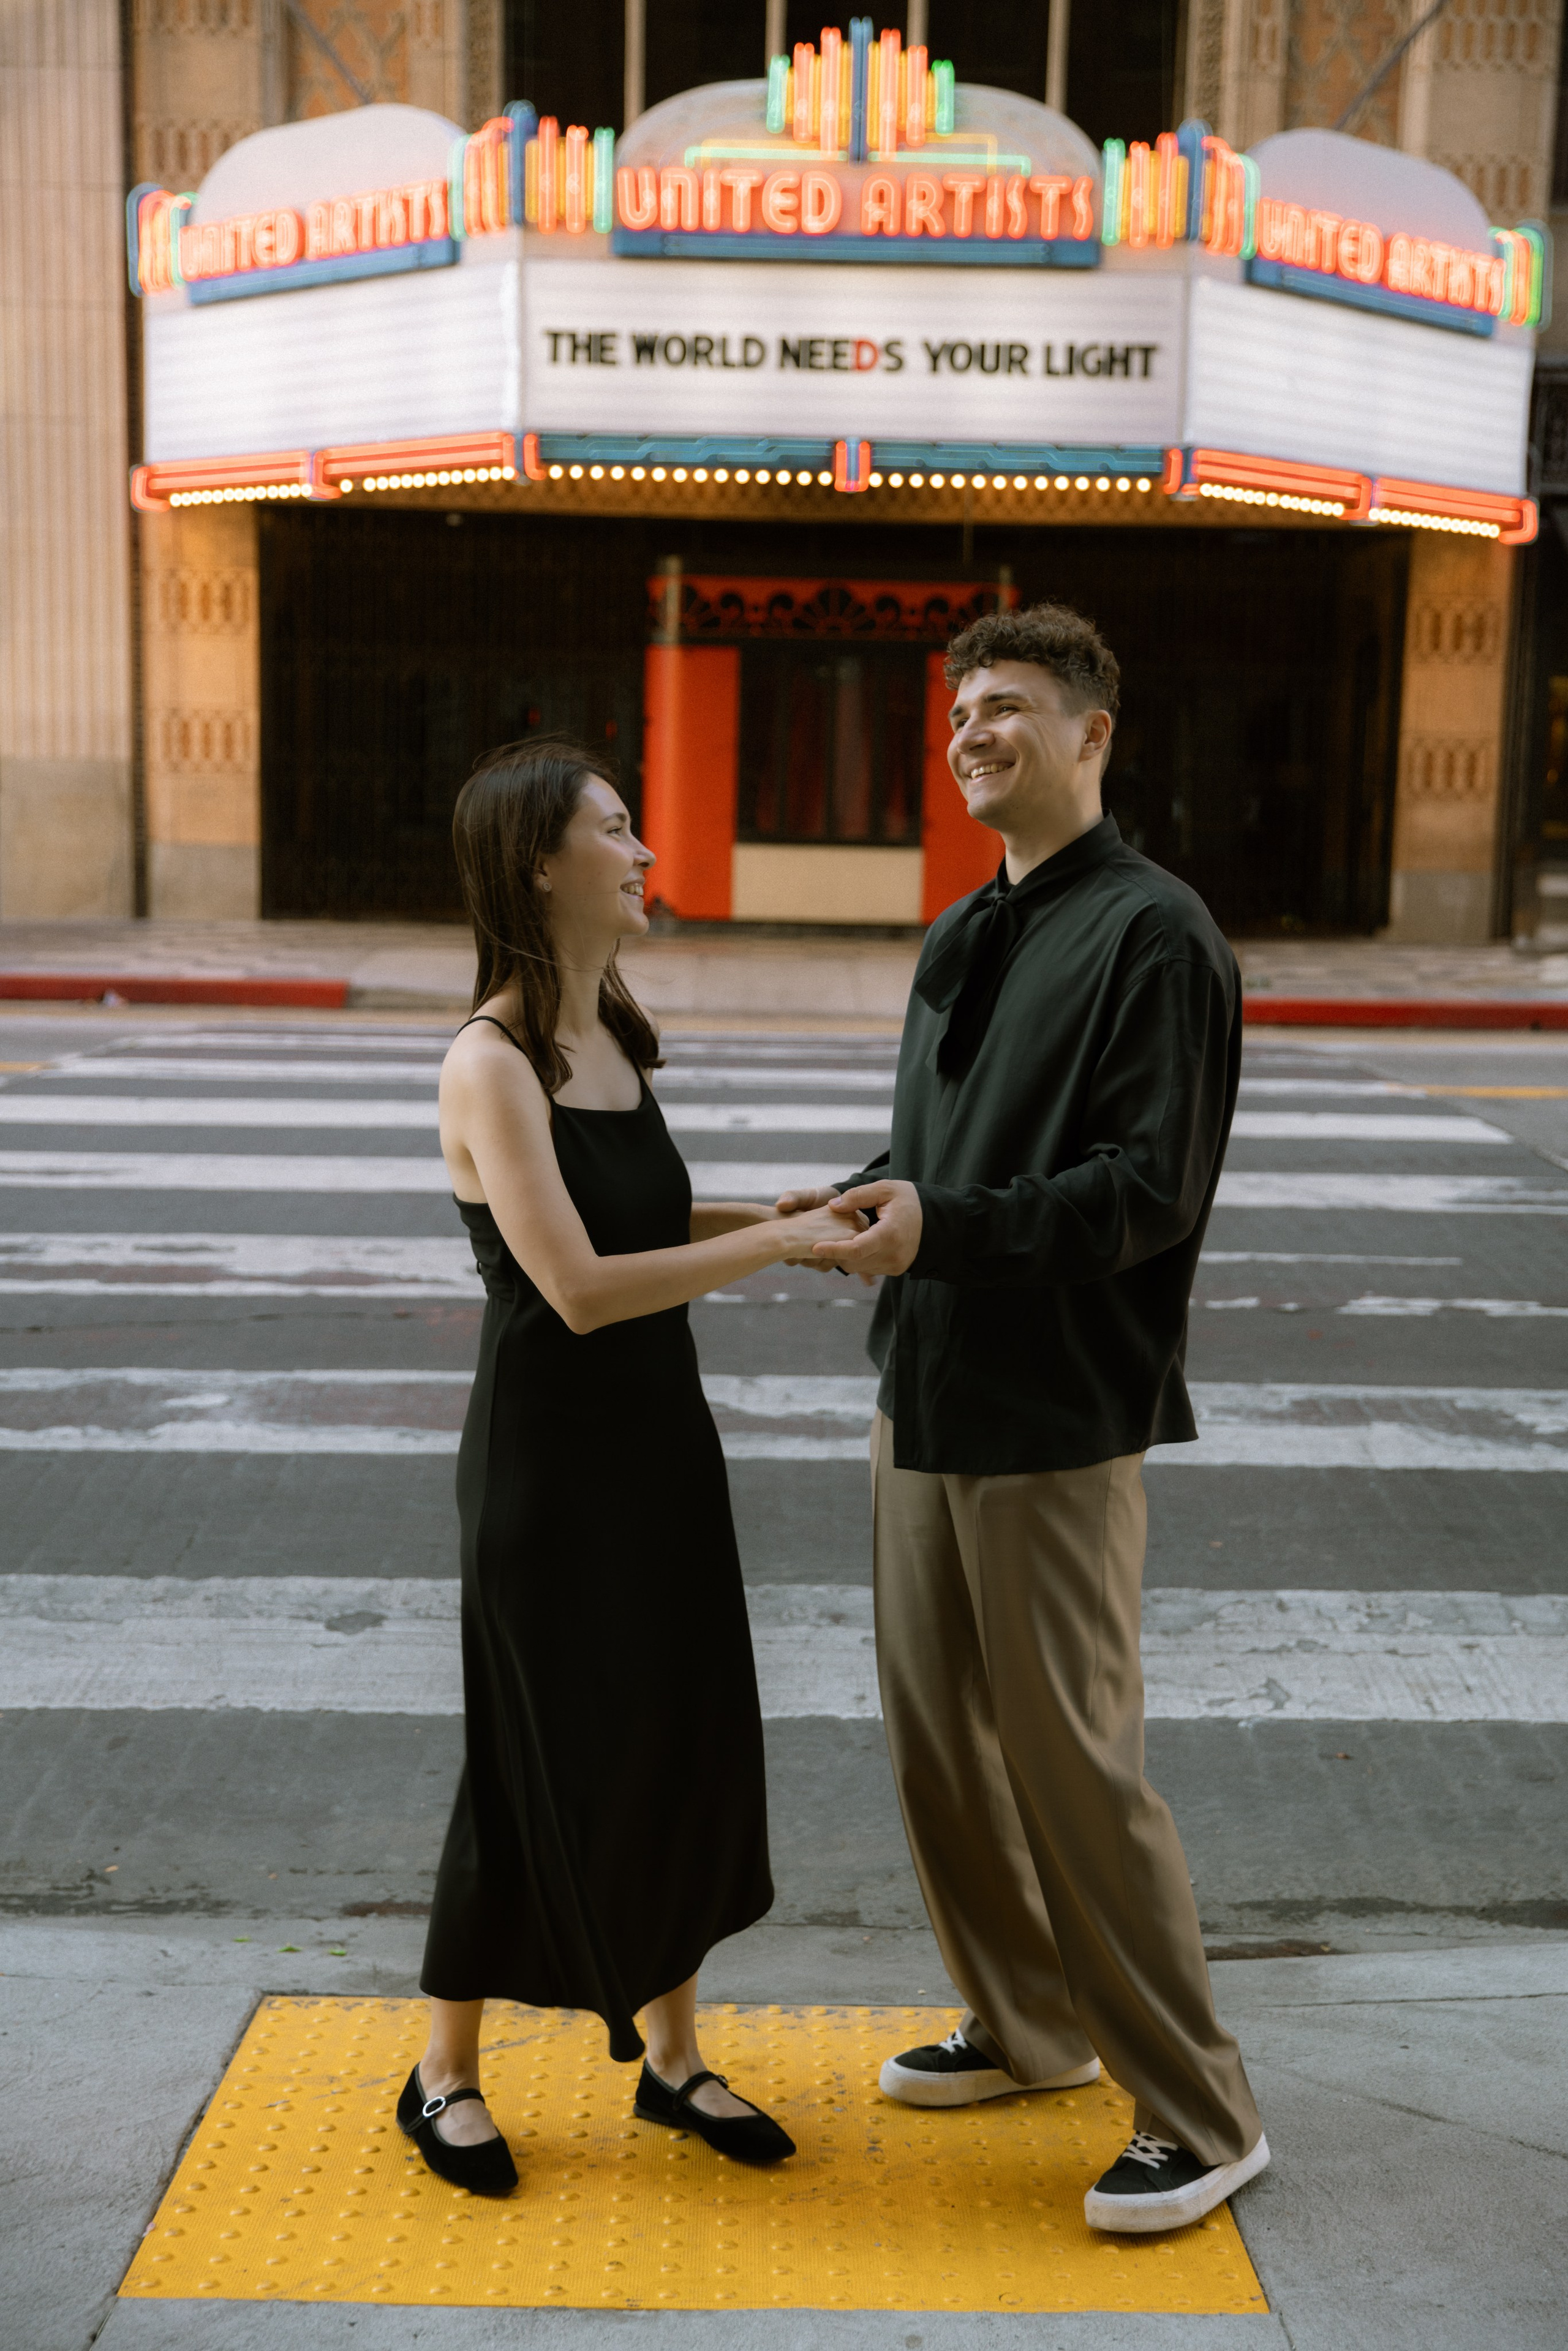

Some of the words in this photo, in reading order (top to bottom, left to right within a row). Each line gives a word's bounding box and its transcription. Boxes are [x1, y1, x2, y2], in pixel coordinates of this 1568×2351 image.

[178, 206, 304, 282] UNITED
[305, 178, 450, 261] ARTISTS
[616, 165, 842, 234] UNITED
[861, 172, 1094, 241] ARTISTS
[1258, 196, 1384, 284] UNITED
[1387, 232, 1507, 316] ARTISTS
[545, 330, 617, 367] THE
[631, 332, 767, 369] WORLD
[778, 336, 904, 373] NEEDS
[924, 340, 1031, 376] YOUR
[1045, 343, 1158, 379] LIGHT
